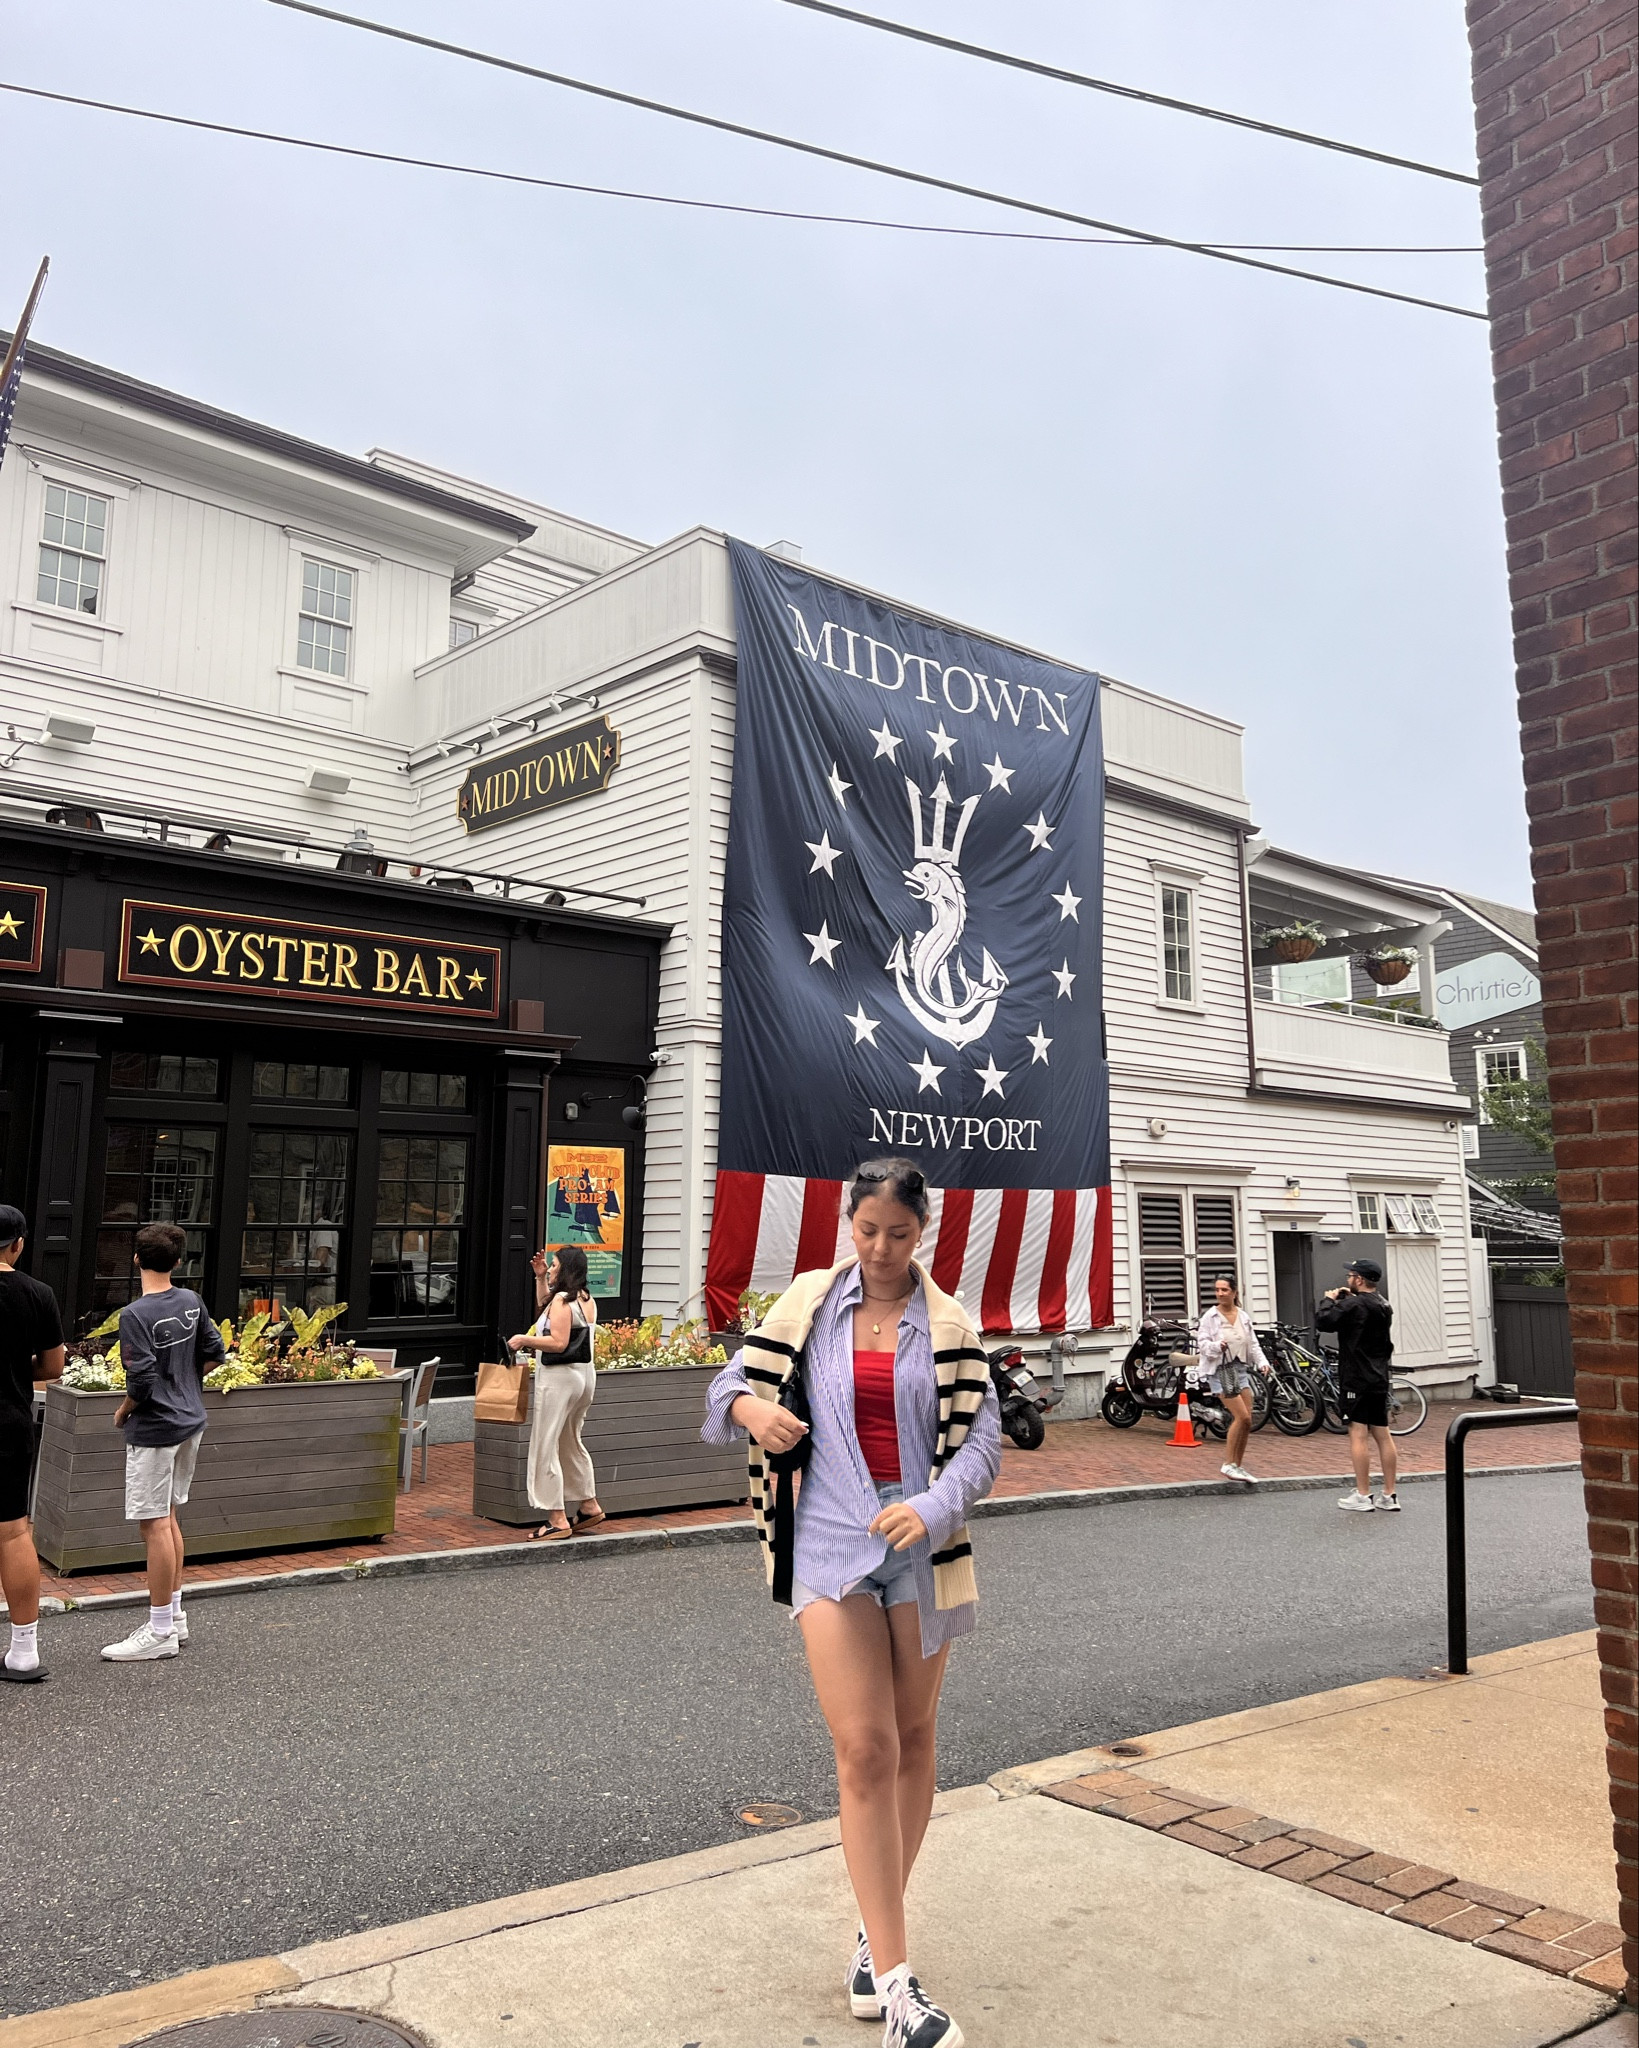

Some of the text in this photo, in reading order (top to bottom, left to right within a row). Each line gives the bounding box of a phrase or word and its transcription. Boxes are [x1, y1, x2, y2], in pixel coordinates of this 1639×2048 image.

[787, 603, 1070, 736] MIDTOWN
[469, 734, 604, 819] MIDTOWN
[169, 923, 465, 1000] OYSTER BAR
[1436, 975, 1534, 1005] Christie's
[868, 1107, 1042, 1151] NEWPORT
[552, 1164, 621, 1179] SURF CLUB
[566, 1152, 608, 1163] M32
[564, 1191, 609, 1204] SERIES
